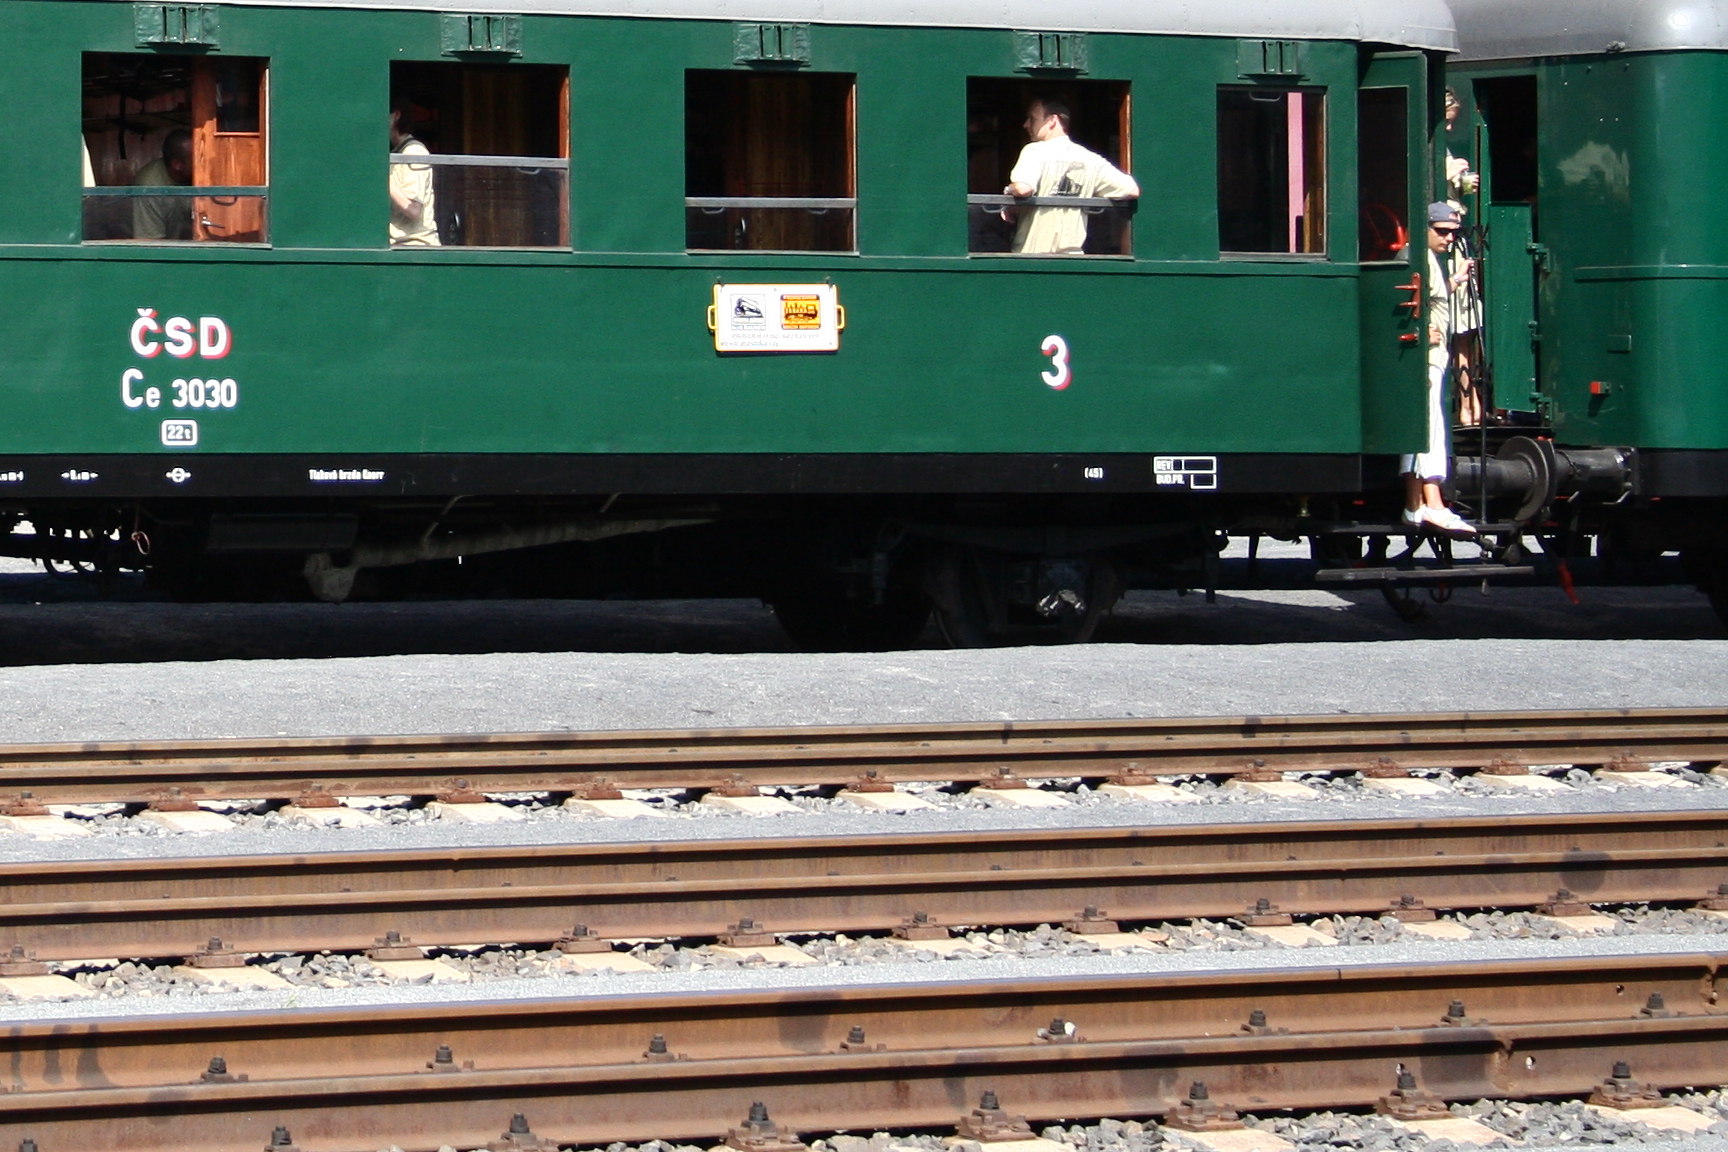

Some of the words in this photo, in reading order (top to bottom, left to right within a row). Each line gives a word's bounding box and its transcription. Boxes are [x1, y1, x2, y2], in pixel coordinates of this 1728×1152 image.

[130, 307, 233, 360] ČSD
[121, 367, 161, 408] Ce
[171, 377, 238, 408] 3030
[1040, 334, 1072, 391] 3
